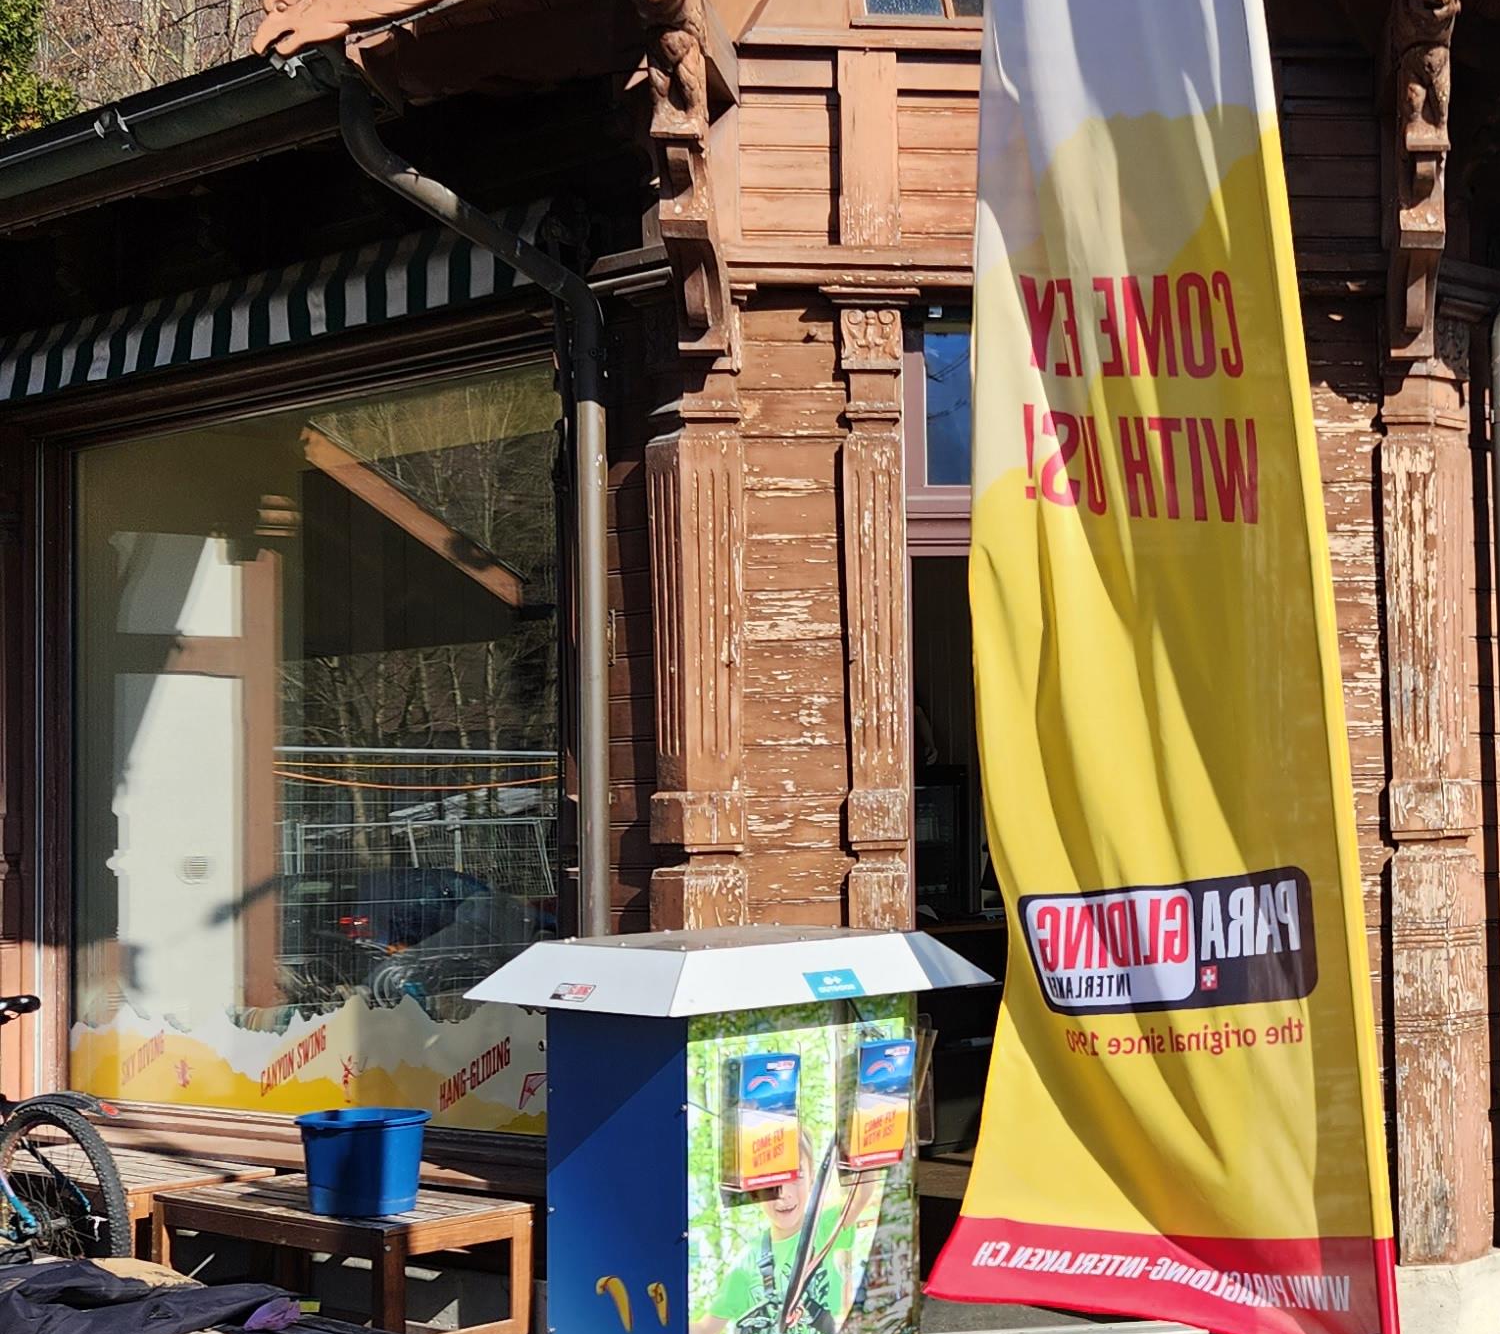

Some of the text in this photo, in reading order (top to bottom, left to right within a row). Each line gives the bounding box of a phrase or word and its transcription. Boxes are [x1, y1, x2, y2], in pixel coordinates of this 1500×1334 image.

[121, 1029, 166, 1087] SKY DIVING
[260, 1023, 328, 1098] CANYON SWING
[438, 1035, 512, 1113] HANG-GLIDING
